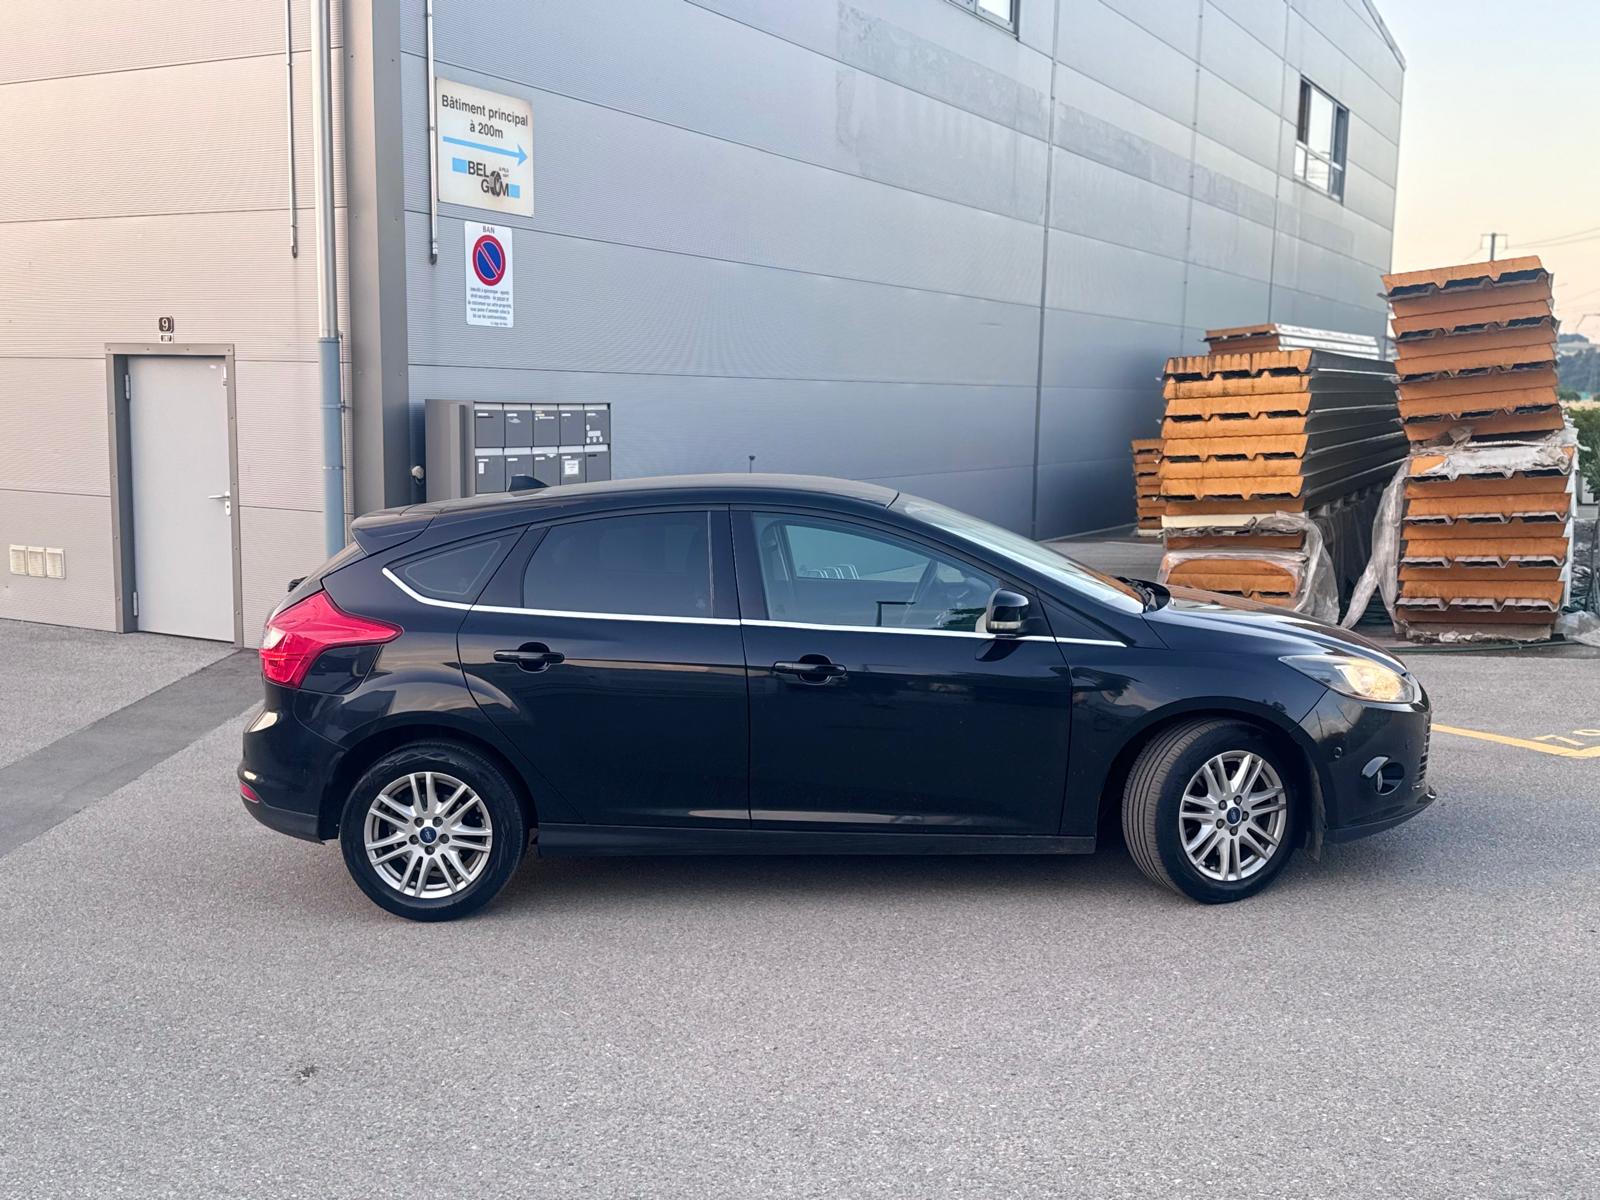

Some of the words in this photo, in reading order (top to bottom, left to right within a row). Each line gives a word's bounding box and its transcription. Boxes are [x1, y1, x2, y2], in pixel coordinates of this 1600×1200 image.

[441, 94, 486, 116] Bâtiment
[488, 108, 528, 127] principal
[469, 120, 476, 133] à
[478, 122, 503, 138] 200m
[467, 160, 490, 178] BEL
[162, 318, 168, 331] 9
